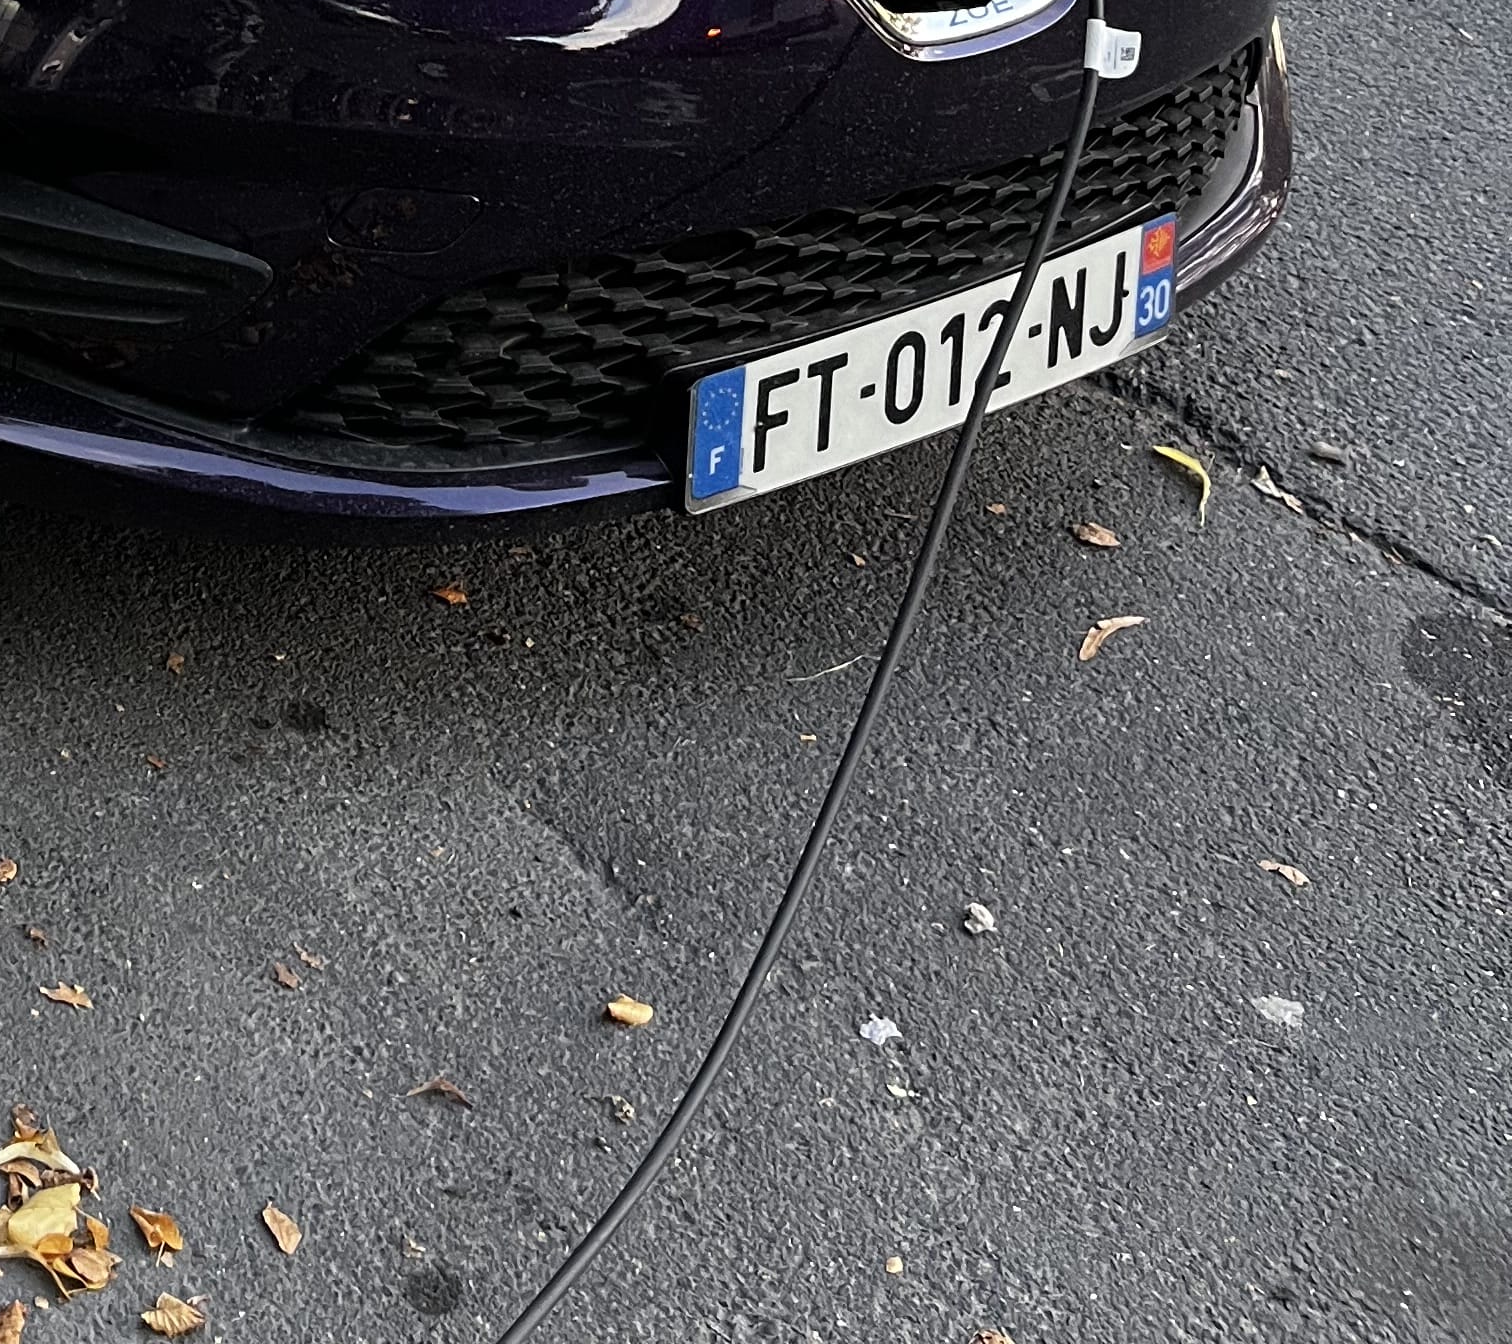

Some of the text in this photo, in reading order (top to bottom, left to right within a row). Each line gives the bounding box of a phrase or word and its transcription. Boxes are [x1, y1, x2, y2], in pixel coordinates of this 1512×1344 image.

[1136, 278, 1171, 327] 30
[753, 251, 1130, 474] FT-012-NJ
[708, 444, 724, 476] F
